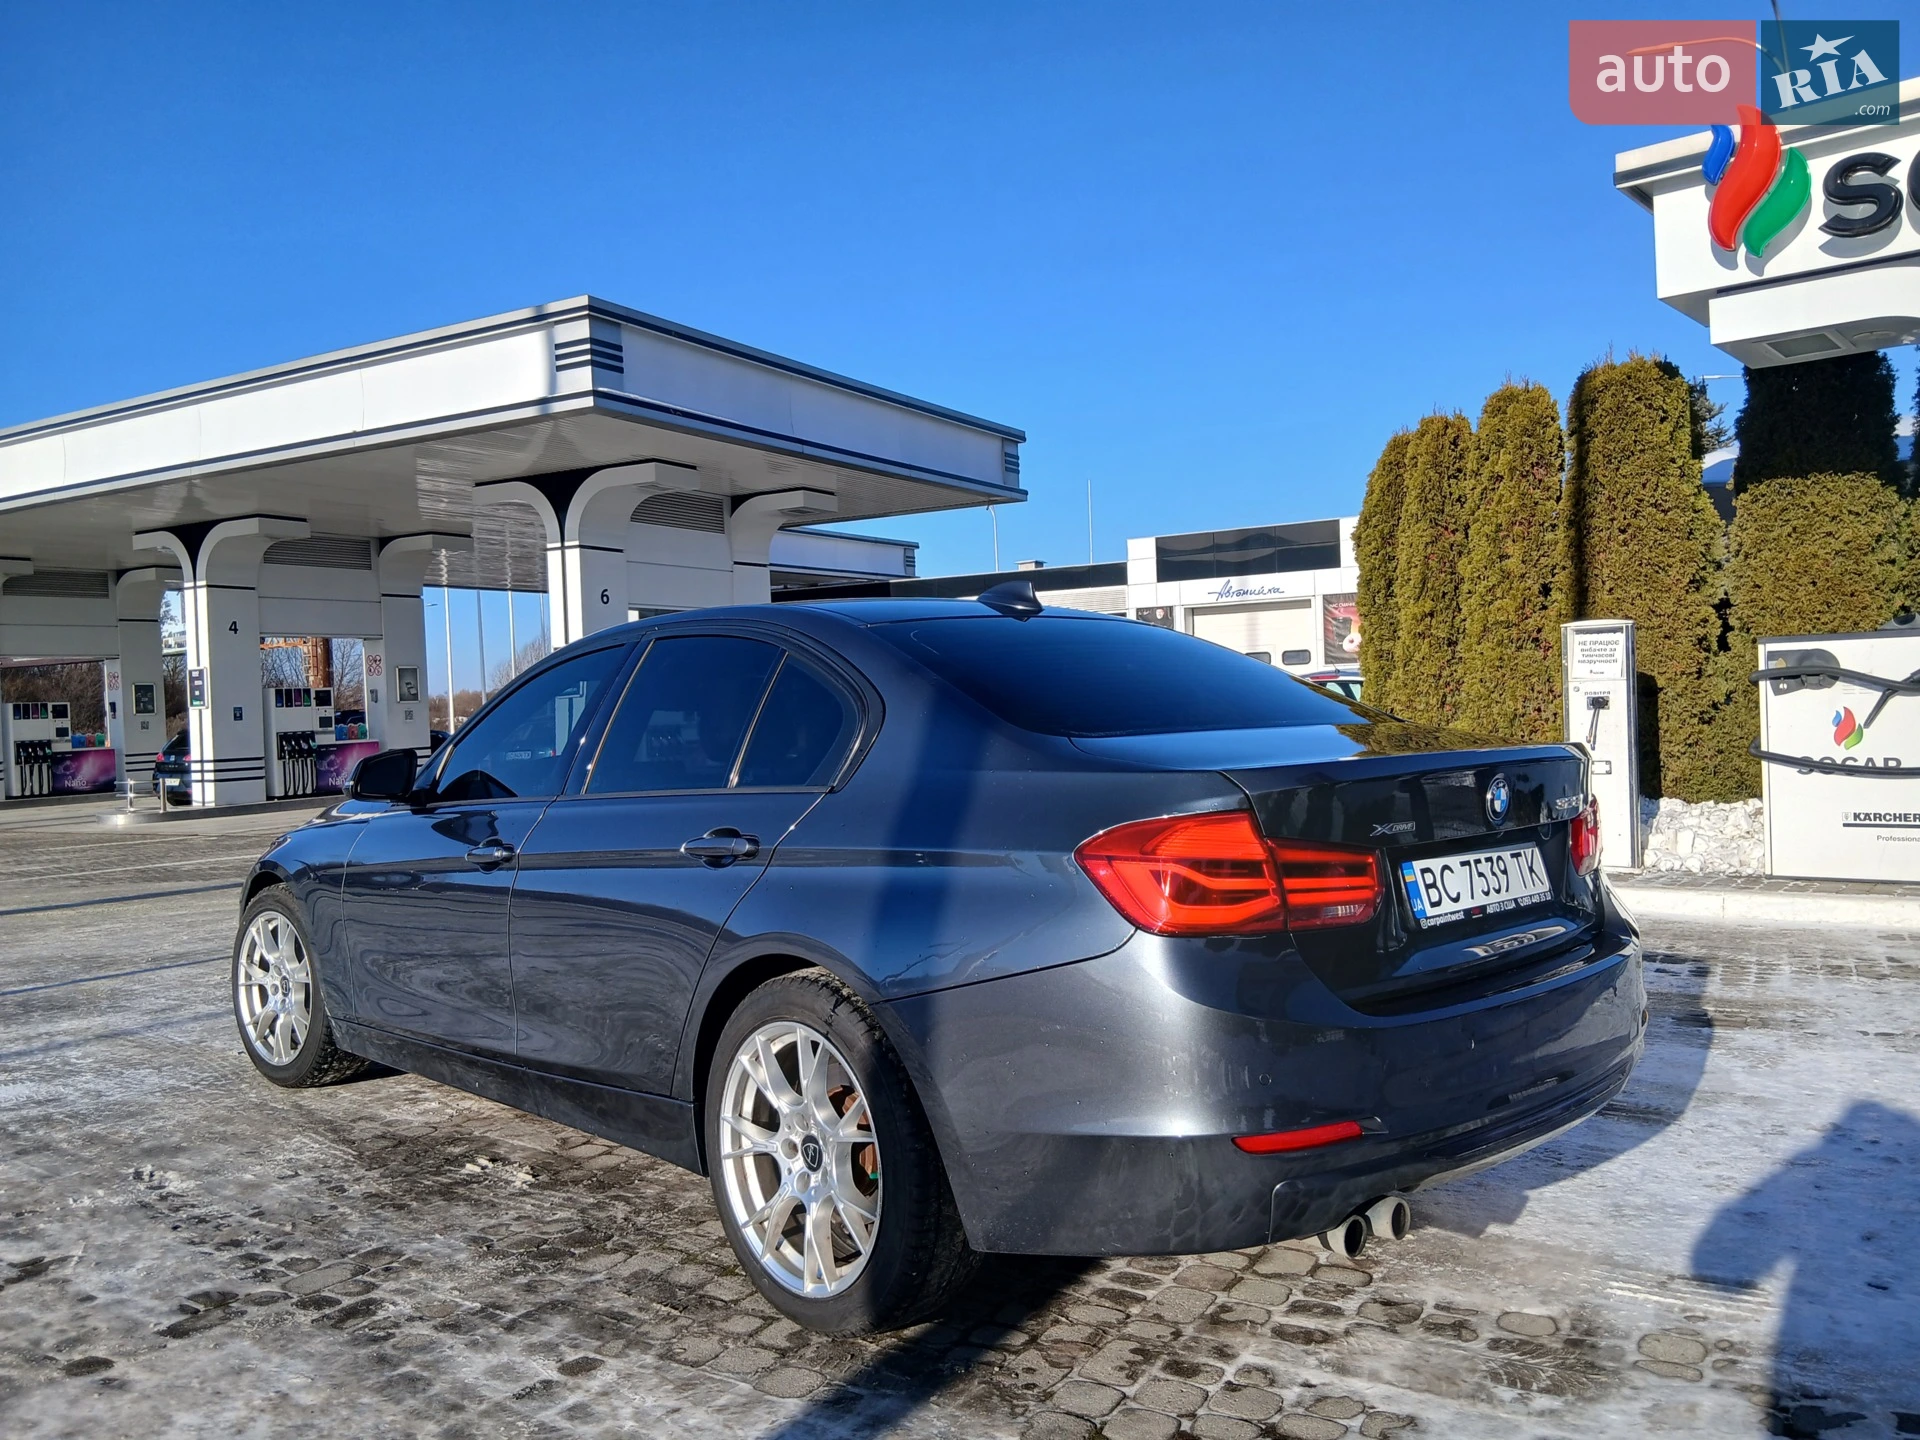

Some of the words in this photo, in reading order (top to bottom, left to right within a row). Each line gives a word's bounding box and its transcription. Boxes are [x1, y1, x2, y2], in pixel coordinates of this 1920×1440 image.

[1818, 151, 1920, 238] S
[600, 588, 610, 605] 6
[1208, 579, 1285, 601] Автомийка
[228, 620, 239, 635] 4
[64, 779, 88, 788] Nano
[1853, 812, 1920, 823] KÄRCHER
[1419, 864, 1461, 909] BC
[1459, 855, 1510, 900] 7539
[1510, 849, 1545, 890] TK
[1411, 898, 1425, 912] UA
